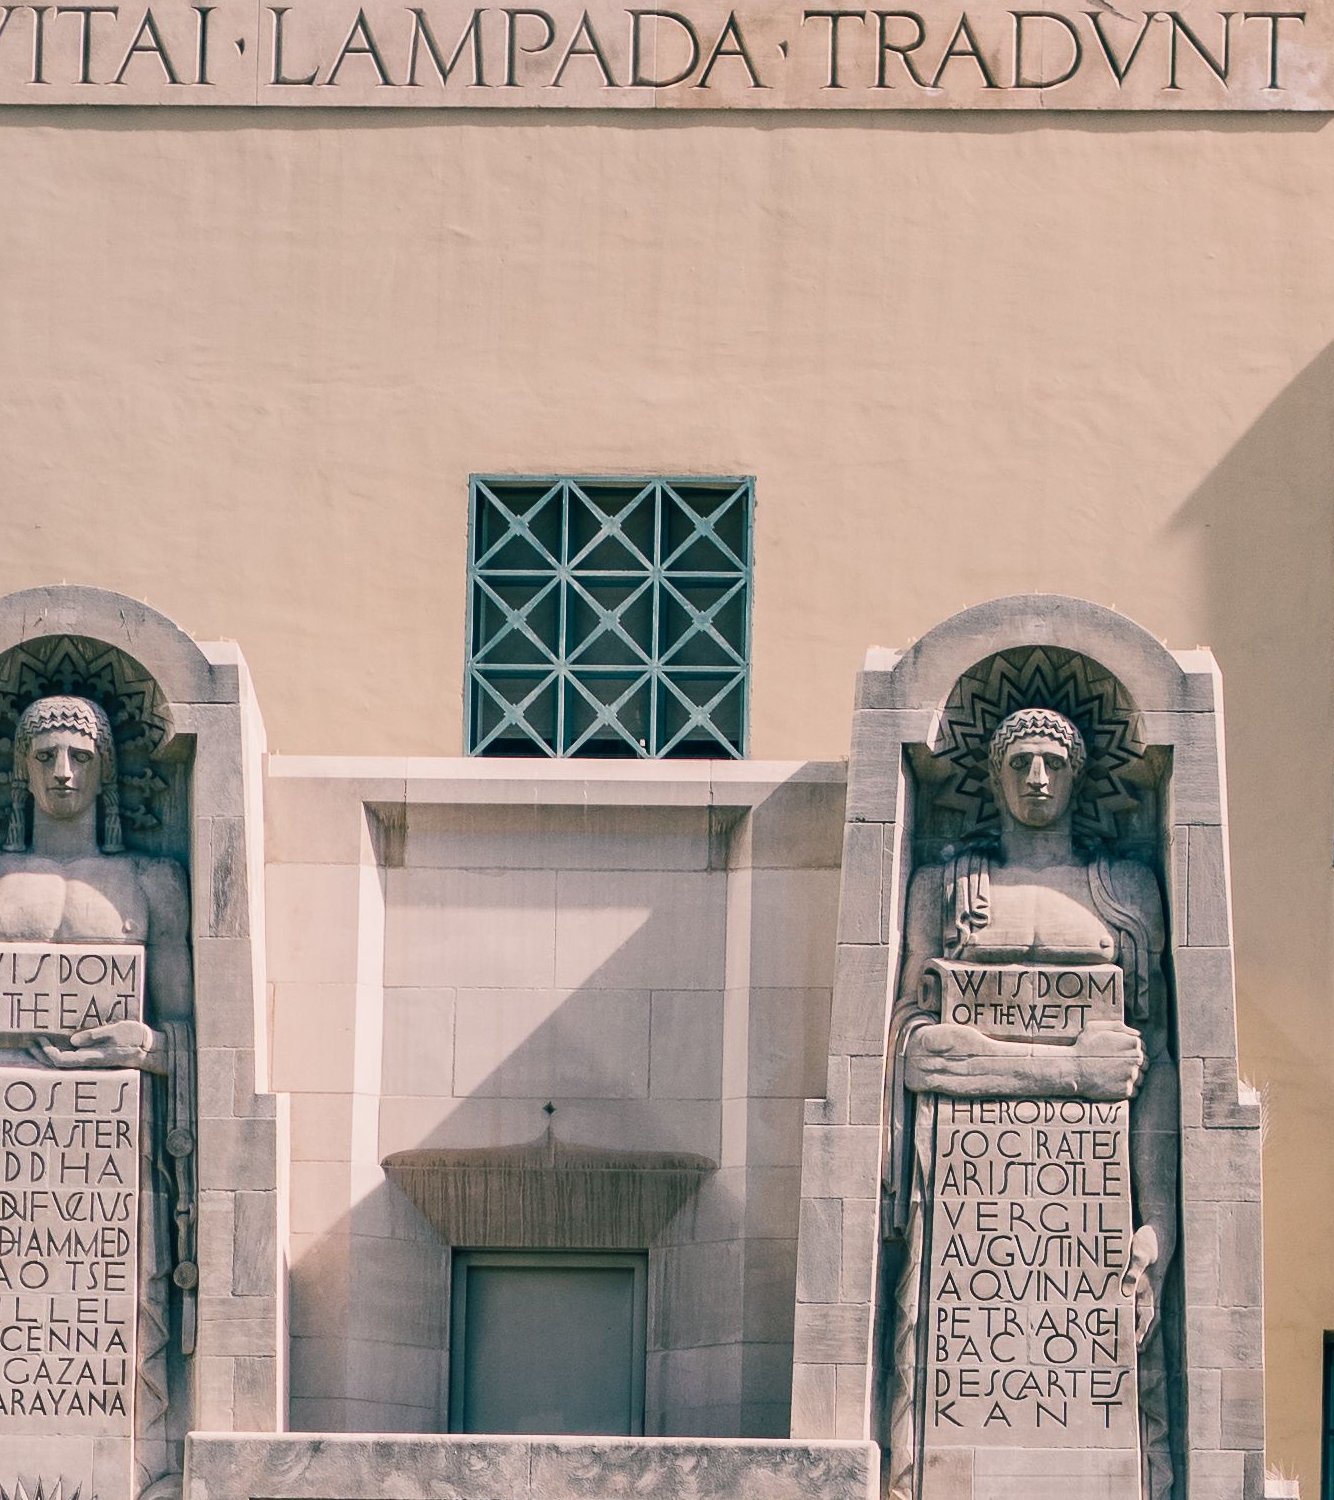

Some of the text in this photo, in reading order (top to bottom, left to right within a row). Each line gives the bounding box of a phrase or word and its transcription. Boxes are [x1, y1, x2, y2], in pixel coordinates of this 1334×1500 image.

[265, 6, 773, 89] LAMPADA
[800, 8, 1308, 91] TRADVNT
[951, 969, 1117, 1005] WISDOM
[2, 992, 50, 1030] THE
[59, 993, 136, 1030] EAST
[951, 1003, 1093, 1033] OF THE WEST
[941, 1129, 1121, 1160] SOCRATES
[940, 1160, 1122, 1197] ARISTOTLE
[942, 1200, 1123, 1234] VERGIL
[940, 1233, 1123, 1268] AUGUSTINE
[65, 1260, 127, 1292] TSE
[936, 1269, 1121, 1302] AQUINAS
[936, 1306, 1120, 1339] PETRARCH
[935, 1331, 1119, 1364] BACON
[2, 1357, 126, 1386] GAZALI
[935, 1368, 1130, 1401] DESCARTES
[934, 1400, 1123, 1428] KANT
